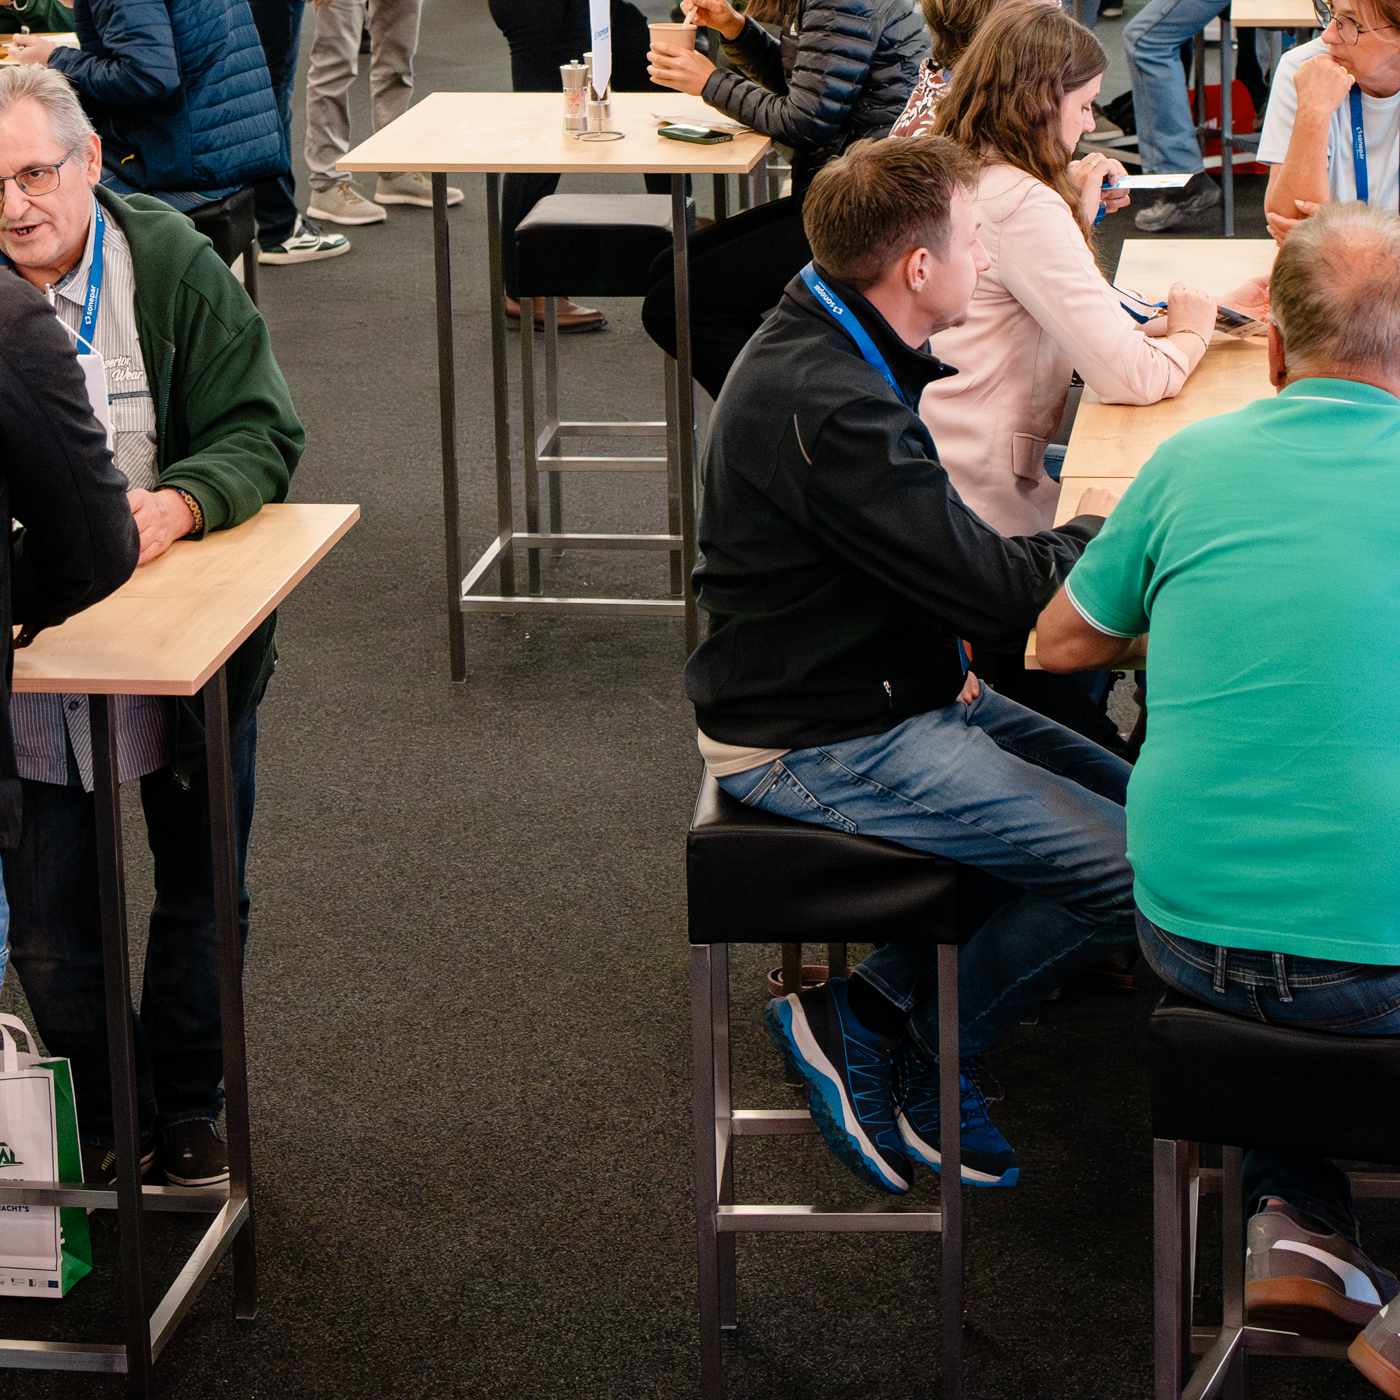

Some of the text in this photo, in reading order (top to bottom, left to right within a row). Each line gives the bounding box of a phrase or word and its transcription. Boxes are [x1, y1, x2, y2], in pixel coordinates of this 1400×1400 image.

[86, 285, 96, 316] sonepar
[813, 284, 836, 308] sonepar
[104, 355, 132, 370] perior
[112, 369, 144, 382] Wear
